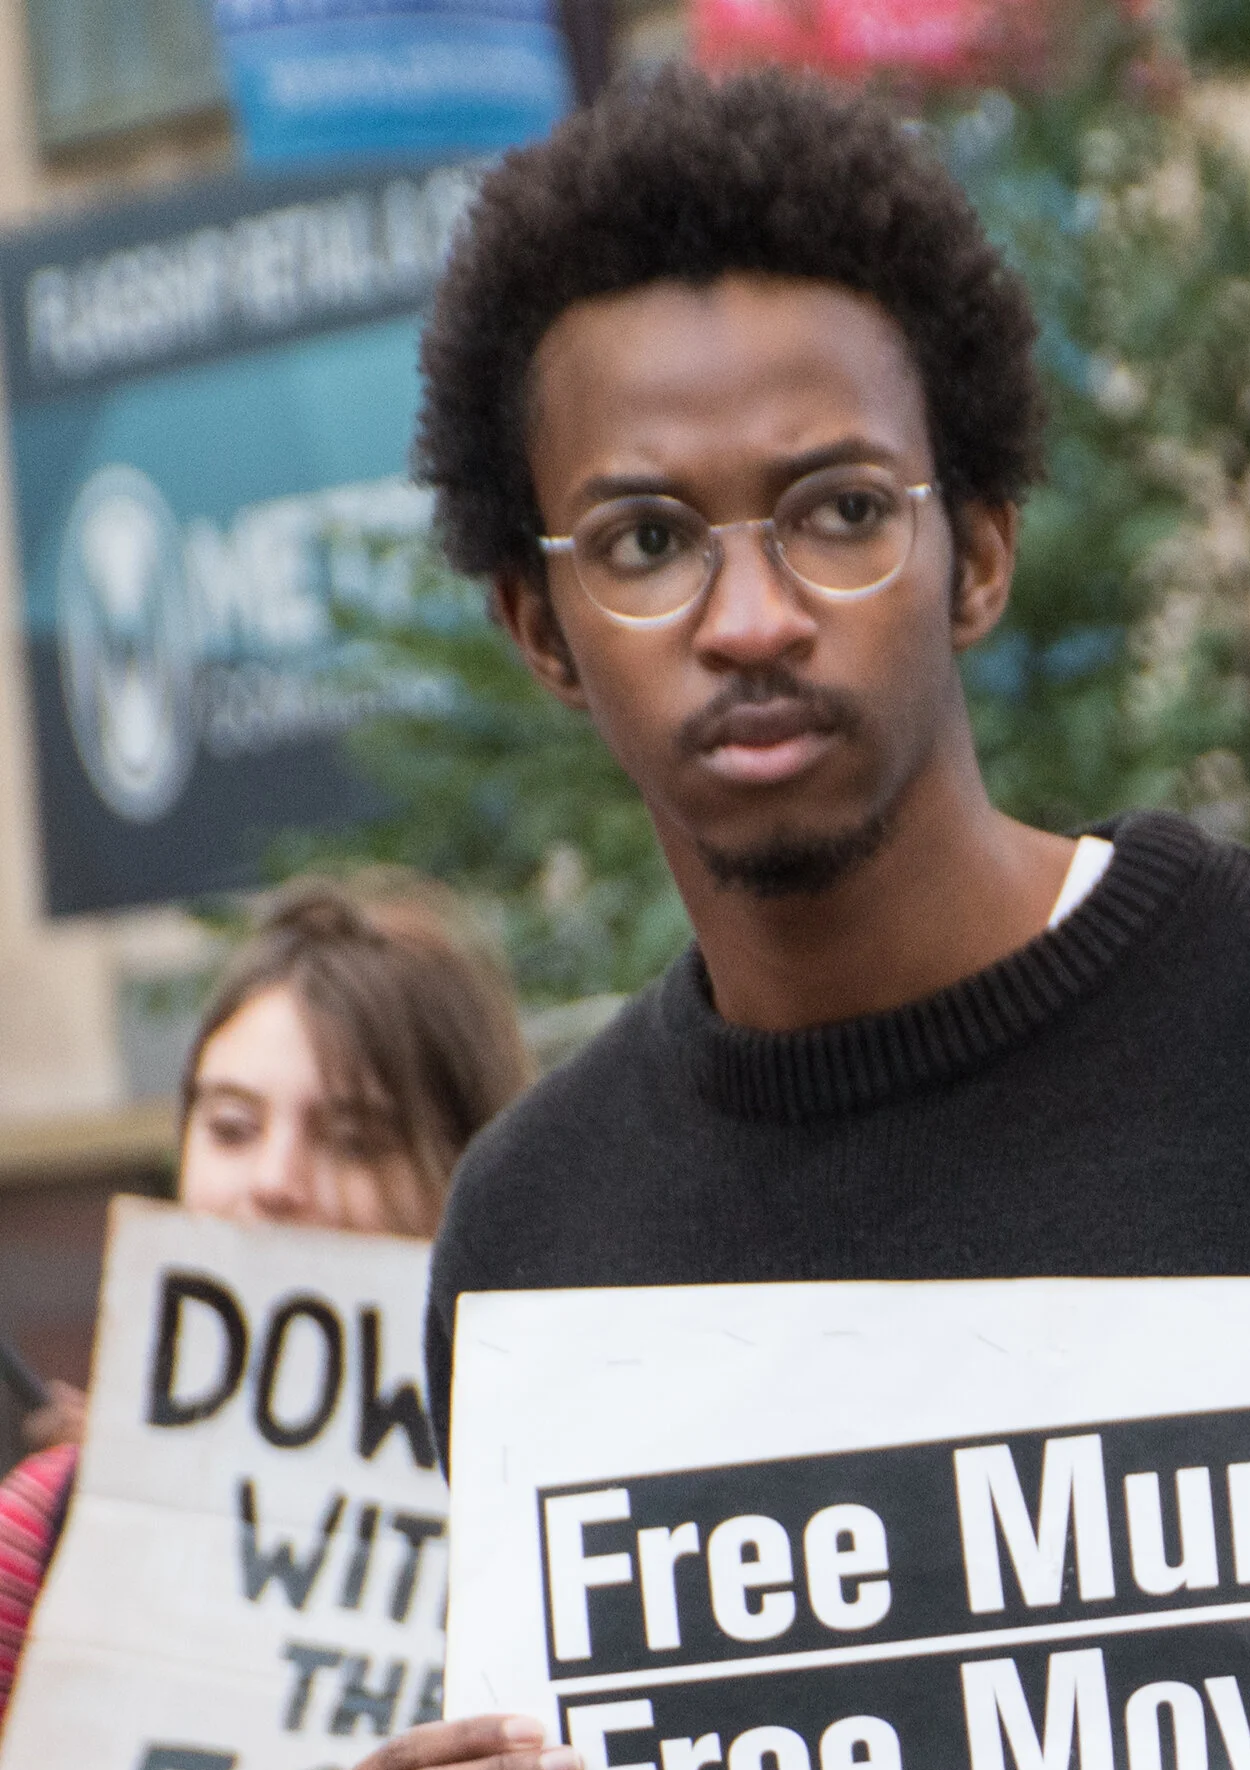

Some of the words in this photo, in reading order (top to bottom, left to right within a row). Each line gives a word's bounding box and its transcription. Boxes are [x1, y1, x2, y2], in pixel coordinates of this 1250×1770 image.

[144, 1267, 438, 1470] DOW
[237, 1475, 448, 1632] WIT
[543, 1488, 894, 1662] Free
